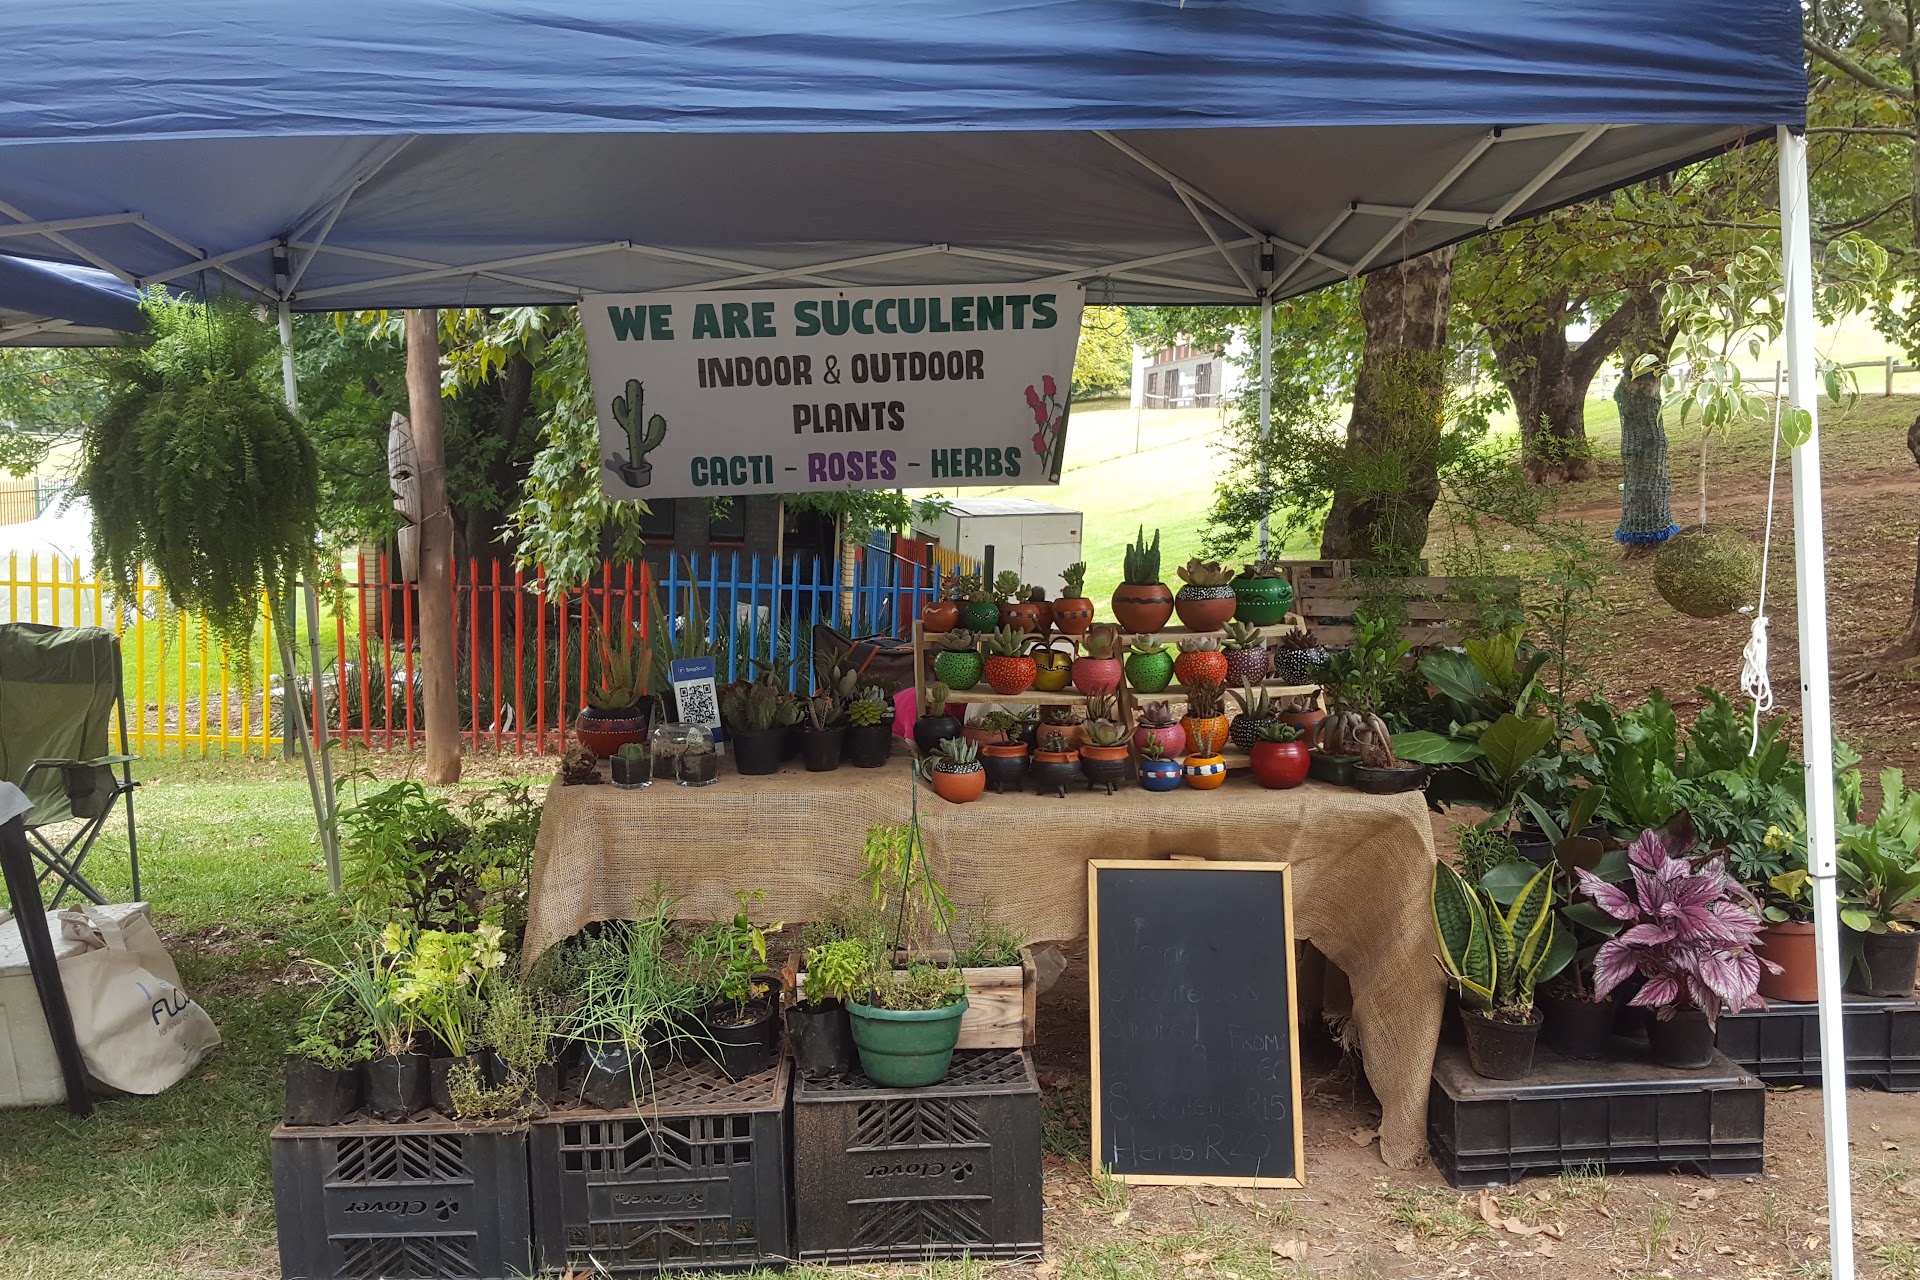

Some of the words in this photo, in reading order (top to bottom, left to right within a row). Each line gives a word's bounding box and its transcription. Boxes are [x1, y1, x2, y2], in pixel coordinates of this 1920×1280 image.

[607, 305, 674, 341] WE
[692, 302, 776, 339] ARE
[795, 294, 1058, 337] SUCCULENTS
[698, 355, 812, 388] INDOOR
[824, 355, 841, 384] &
[852, 349, 985, 382] OUTDOOR
[793, 401, 905, 434] PLANTS
[690, 455, 774, 486] CACTI
[808, 450, 897, 483] ROSES
[931, 447, 1022, 479] HERBS
[864, 1162, 945, 1179] Clover
[343, 1200, 427, 1216] Clover
[622, 1193, 683, 1205] Clover
